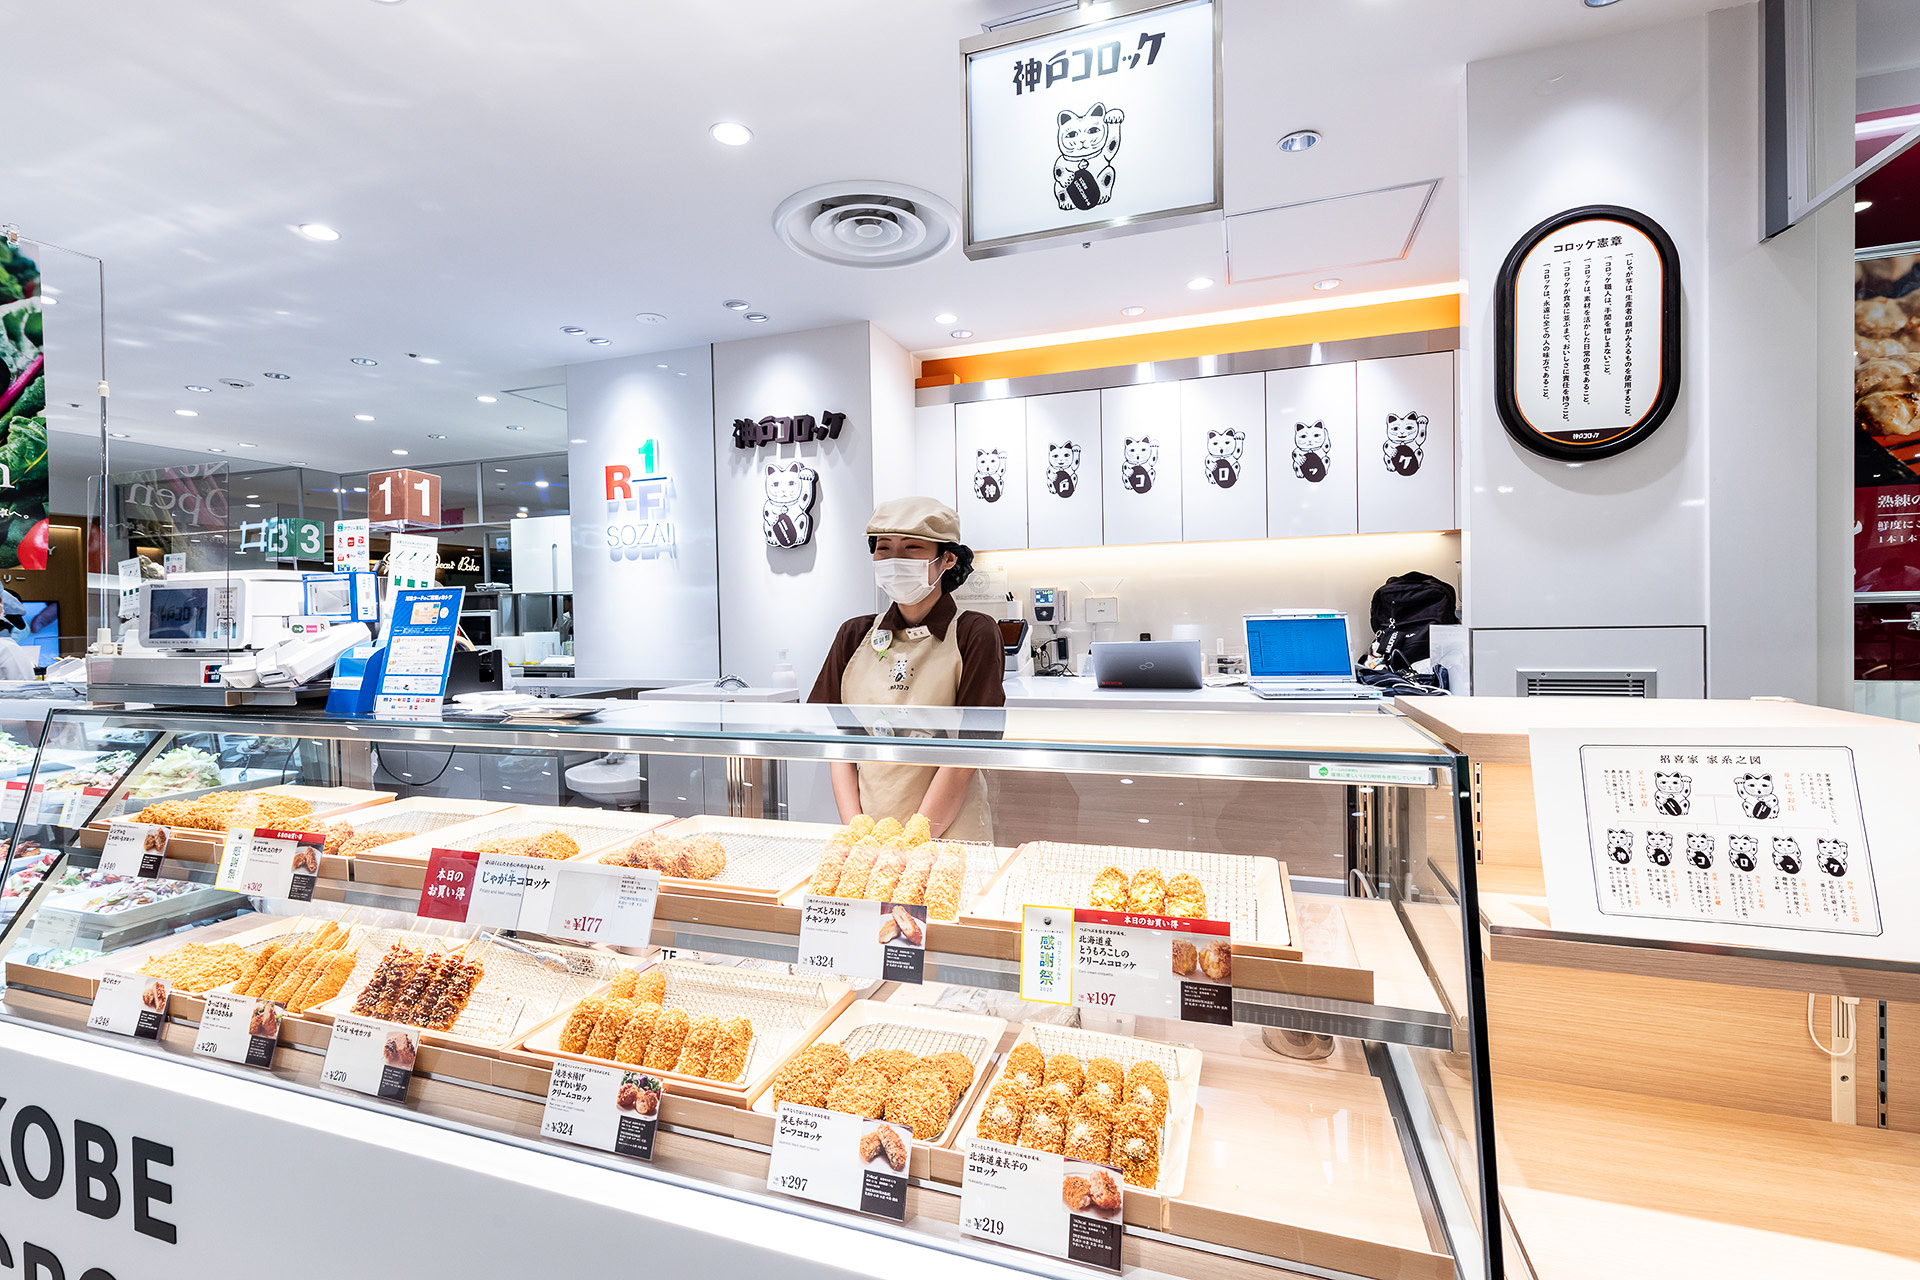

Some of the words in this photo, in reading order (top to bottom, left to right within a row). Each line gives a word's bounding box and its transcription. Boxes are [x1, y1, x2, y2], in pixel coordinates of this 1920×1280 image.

[1012, 32, 1166, 96] 神戸コロッケ
[1553, 235, 1623, 253] コロッケ憲章
[732, 410, 847, 449] 神戸コロッケ
[1398, 454, 1413, 470] ケ
[1059, 479, 1070, 492] 戸
[1135, 474, 1146, 488] コ
[378, 476, 392, 516] 1
[413, 478, 431, 517] 1
[300, 523, 321, 554] 3
[606, 523, 672, 547] SOZAI
[436, 867, 465, 883] 本日の
[481, 870, 551, 891] じゃが牛コロッケ
[427, 883, 467, 901] お買い得
[805, 906, 847, 918] チーズとろける
[805, 915, 838, 925] チキンカツ
[572, 916, 603, 934] ¥177
[1123, 916, 1179, 929] 本日のお買い得
[1078, 935, 1113, 947] 北海道産
[1039, 935, 1055, 986] 感謝祭
[1079, 946, 1130, 959] とうもろこしの
[809, 955, 835, 969] ¥324
[1079, 956, 1137, 970] クリームコロッケ
[1086, 991, 1117, 1007] ¥197
[94, 1016, 110, 1027] ¥248
[201, 1041, 218, 1053] ¥270
[329, 1070, 348, 1083] ¥270
[551, 1088, 593, 1103] クリームコロッケ
[551, 1121, 574, 1136] ¥324
[780, 1114, 818, 1130] 黒毛和牛の
[780, 1126, 823, 1142] ビーフコロッケ
[969, 1152, 1029, 1172] 北海道産長芋の
[968, 1164, 999, 1178] コロッケ
[781, 1175, 808, 1192] ¥297
[974, 1217, 1005, 1236] ¥219
